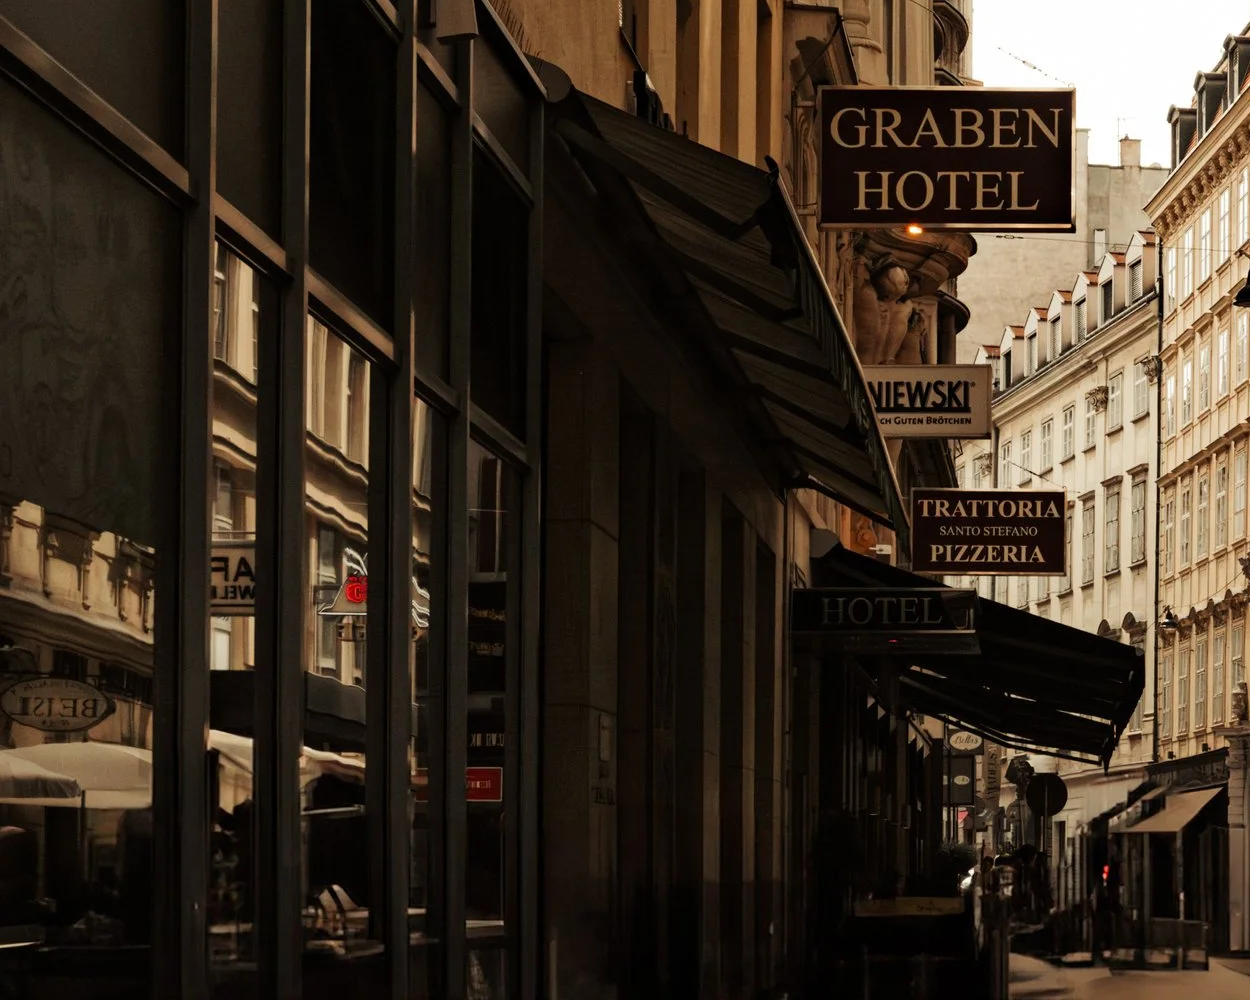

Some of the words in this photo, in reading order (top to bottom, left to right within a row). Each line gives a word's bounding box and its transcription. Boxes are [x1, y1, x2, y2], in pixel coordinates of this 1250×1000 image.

[830, 107, 1064, 149] GRABEN
[852, 170, 1040, 212] HOTEL
[867, 380, 970, 409] NIEWSKI
[917, 499, 1061, 519] TRATTORIA
[939, 525, 981, 537] SANTO
[983, 525, 1039, 537] STEFANO
[929, 543, 1047, 563] PIZZERIA
[821, 596, 943, 625] HOTEL
